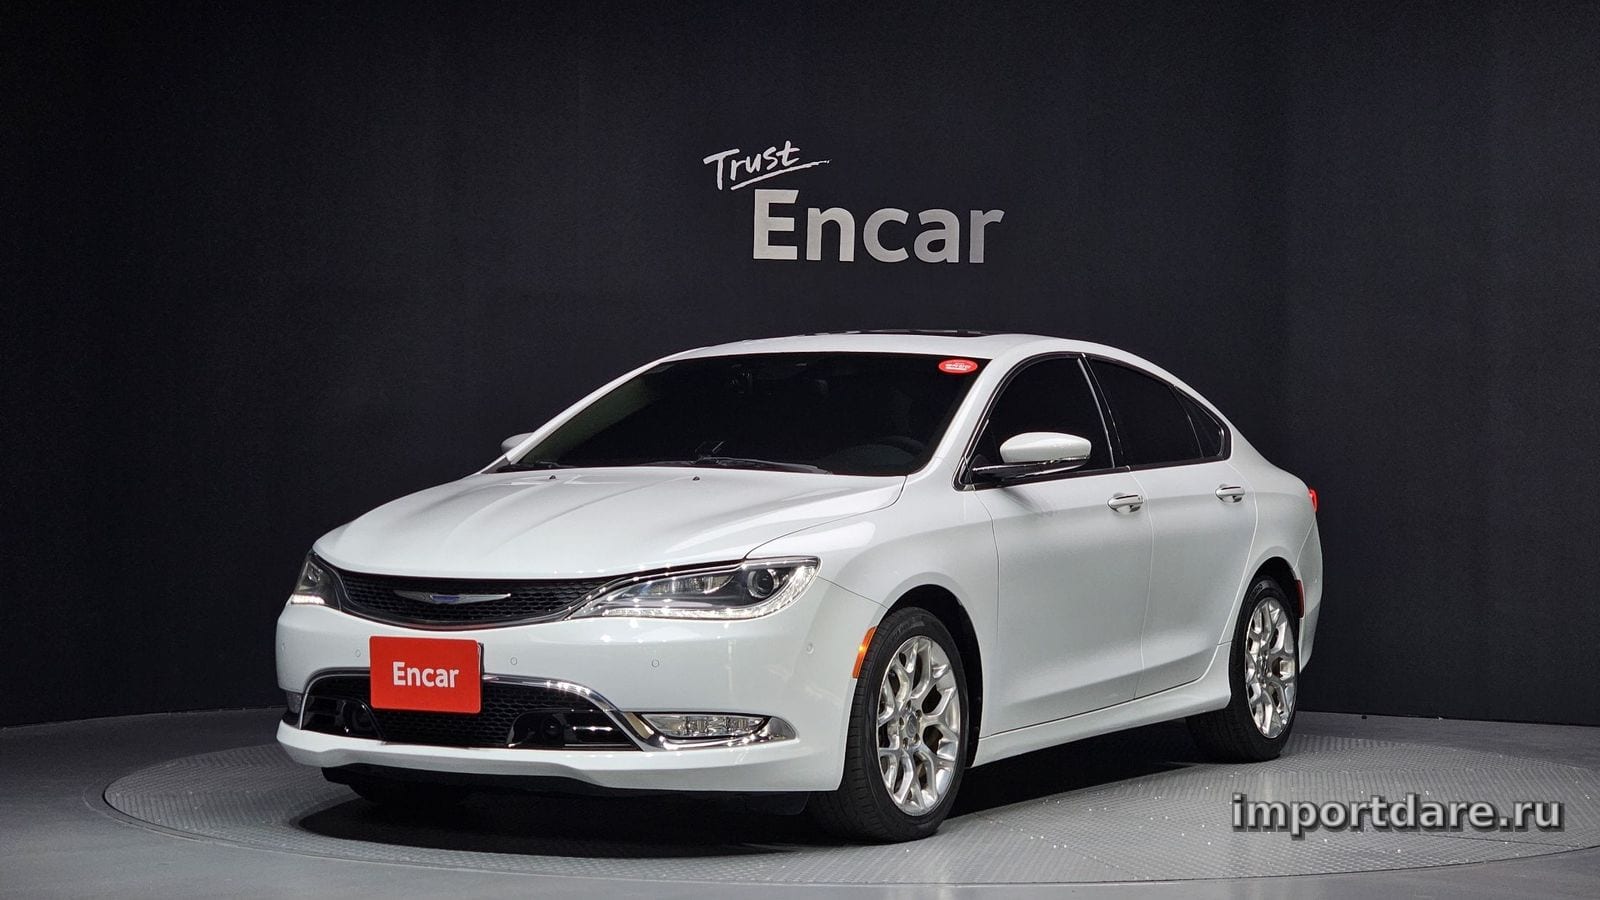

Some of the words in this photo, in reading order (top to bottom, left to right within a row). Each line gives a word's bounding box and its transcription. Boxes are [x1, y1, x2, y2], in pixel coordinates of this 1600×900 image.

[703, 140, 800, 190] Trust
[753, 189, 1005, 263] Encar
[392, 661, 460, 688] Encar
